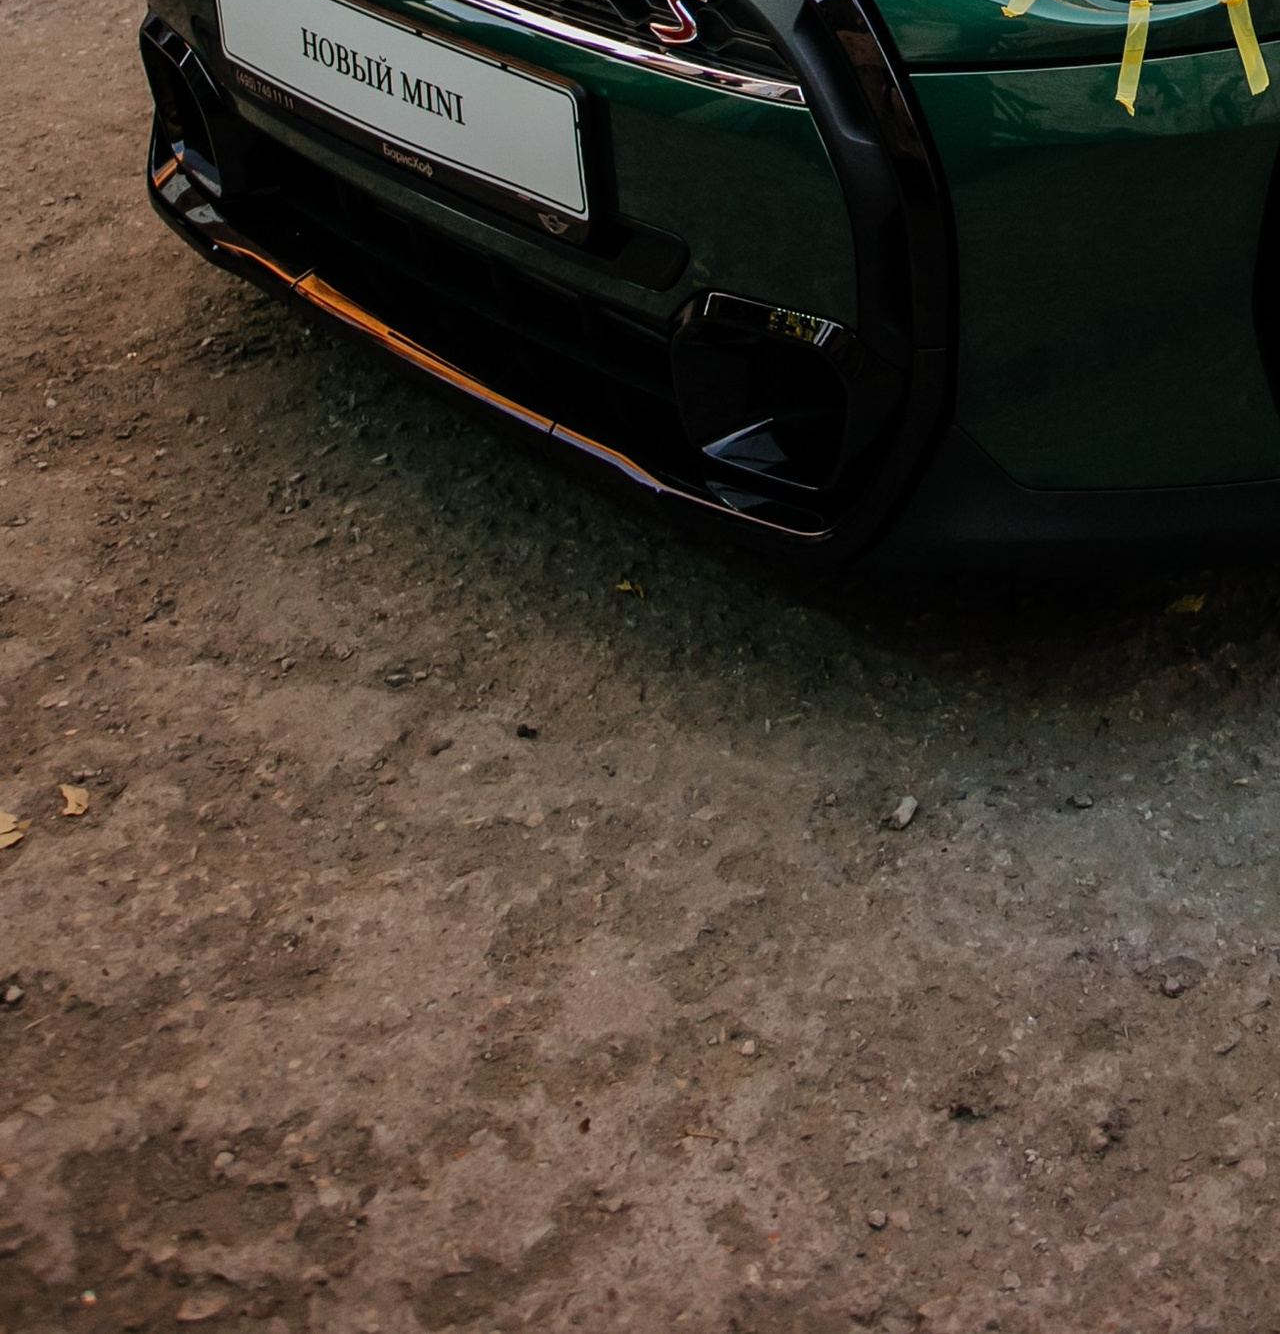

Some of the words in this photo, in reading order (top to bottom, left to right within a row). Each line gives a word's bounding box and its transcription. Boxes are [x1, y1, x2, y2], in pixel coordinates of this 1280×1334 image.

[300, 26, 395, 98] НОВЫЙ
[400, 70, 467, 127] MINI
[382, 142, 434, 178] БорисХоф
